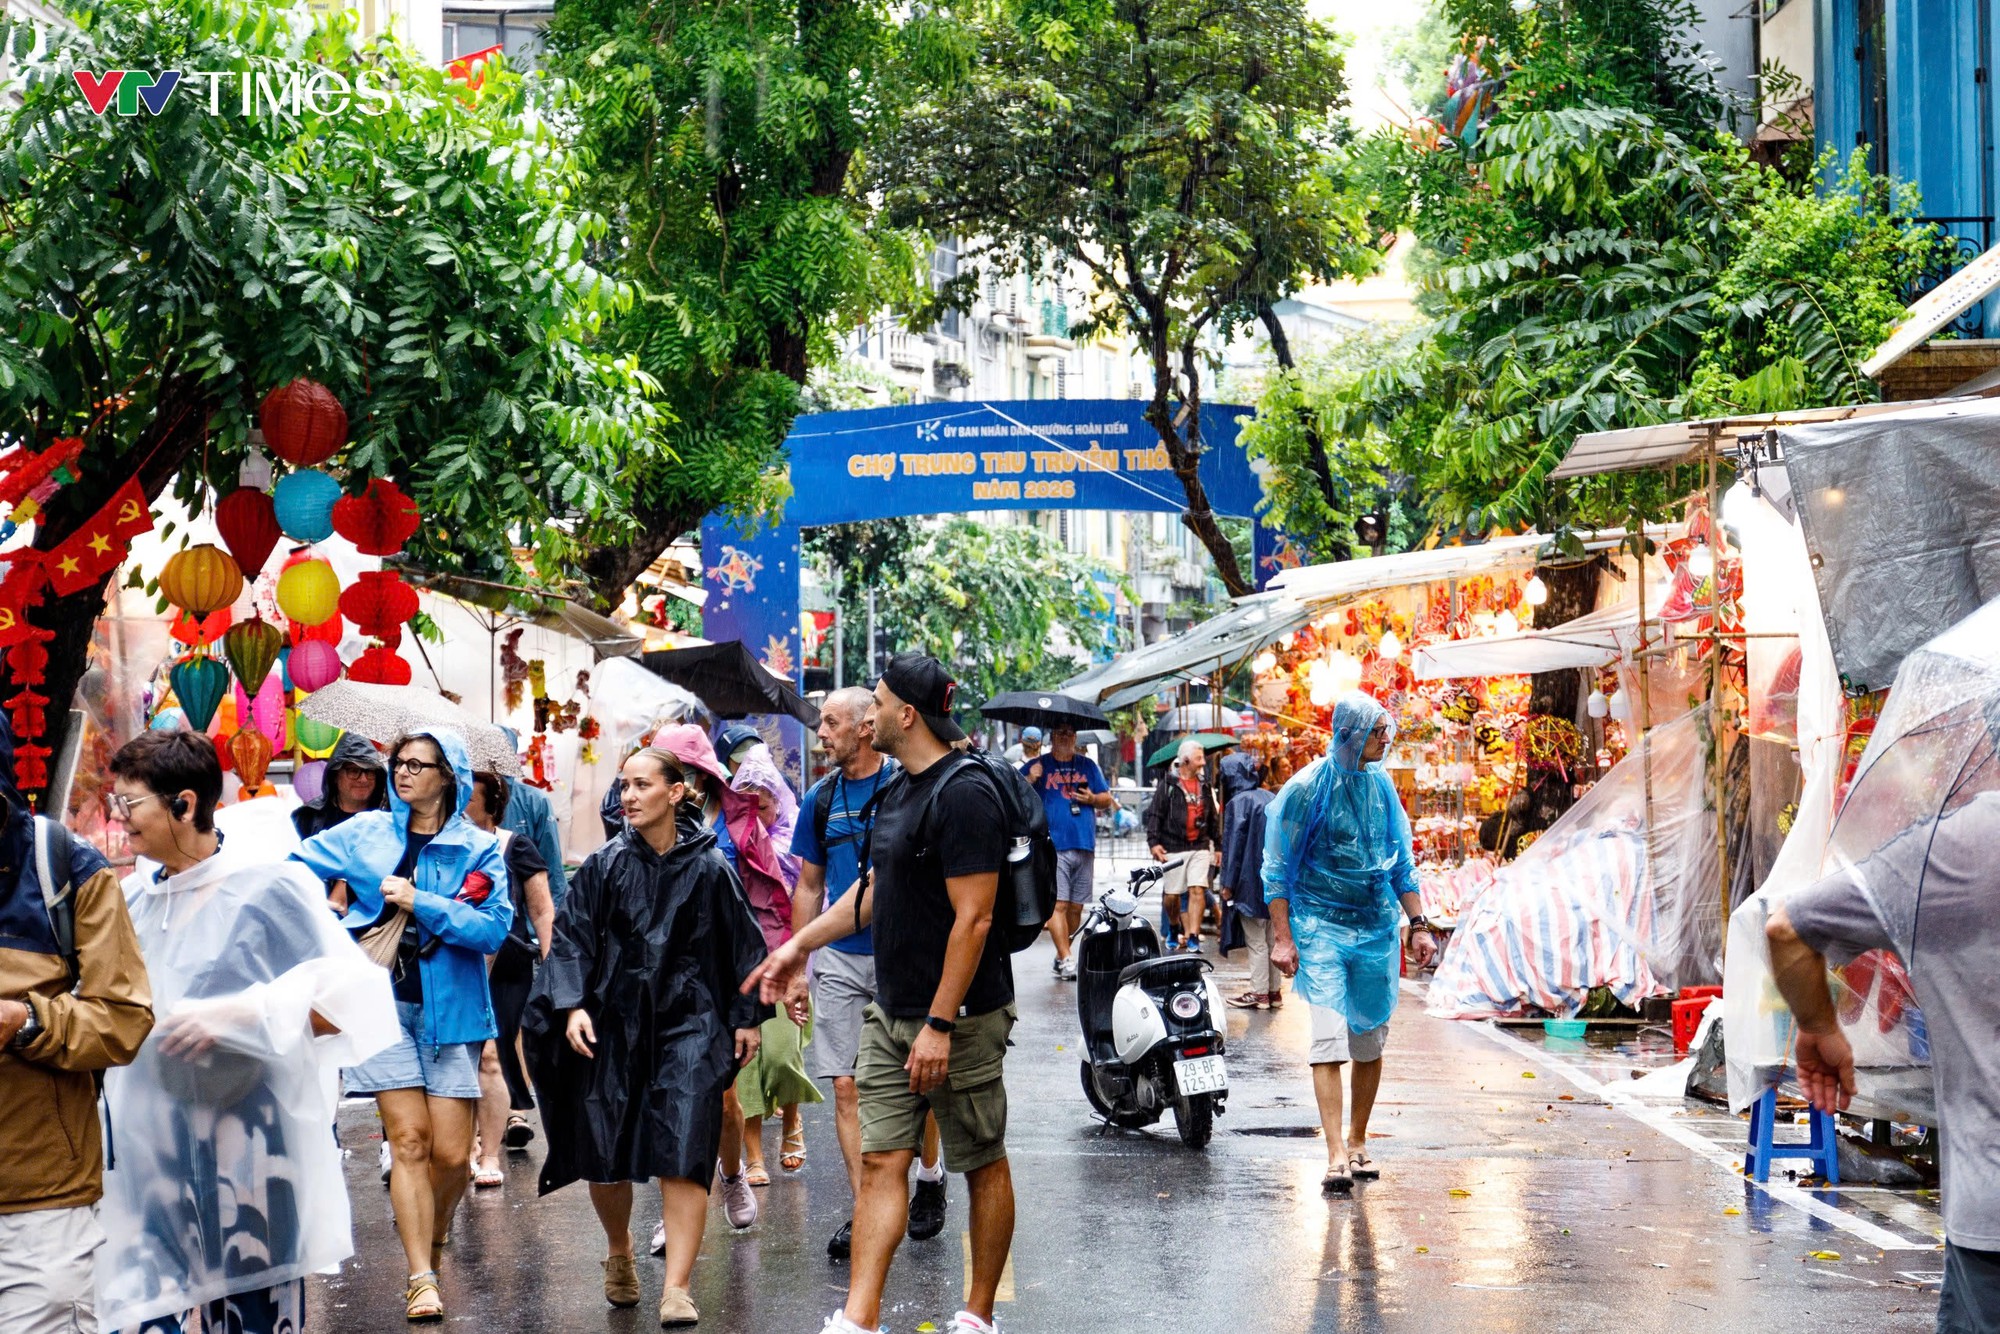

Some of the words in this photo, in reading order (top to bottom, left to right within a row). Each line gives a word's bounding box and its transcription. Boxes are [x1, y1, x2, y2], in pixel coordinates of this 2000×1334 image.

[958, 426, 979, 437] BAN
[848, 452, 896, 481] CHỢ
[900, 452, 976, 476] TRUNG
[981, 451, 1026, 474] THU
[1024, 480, 1076, 499] 2026
[1182, 1059, 1215, 1077] 29-BF
[1183, 1073, 1225, 1092] 125.13
